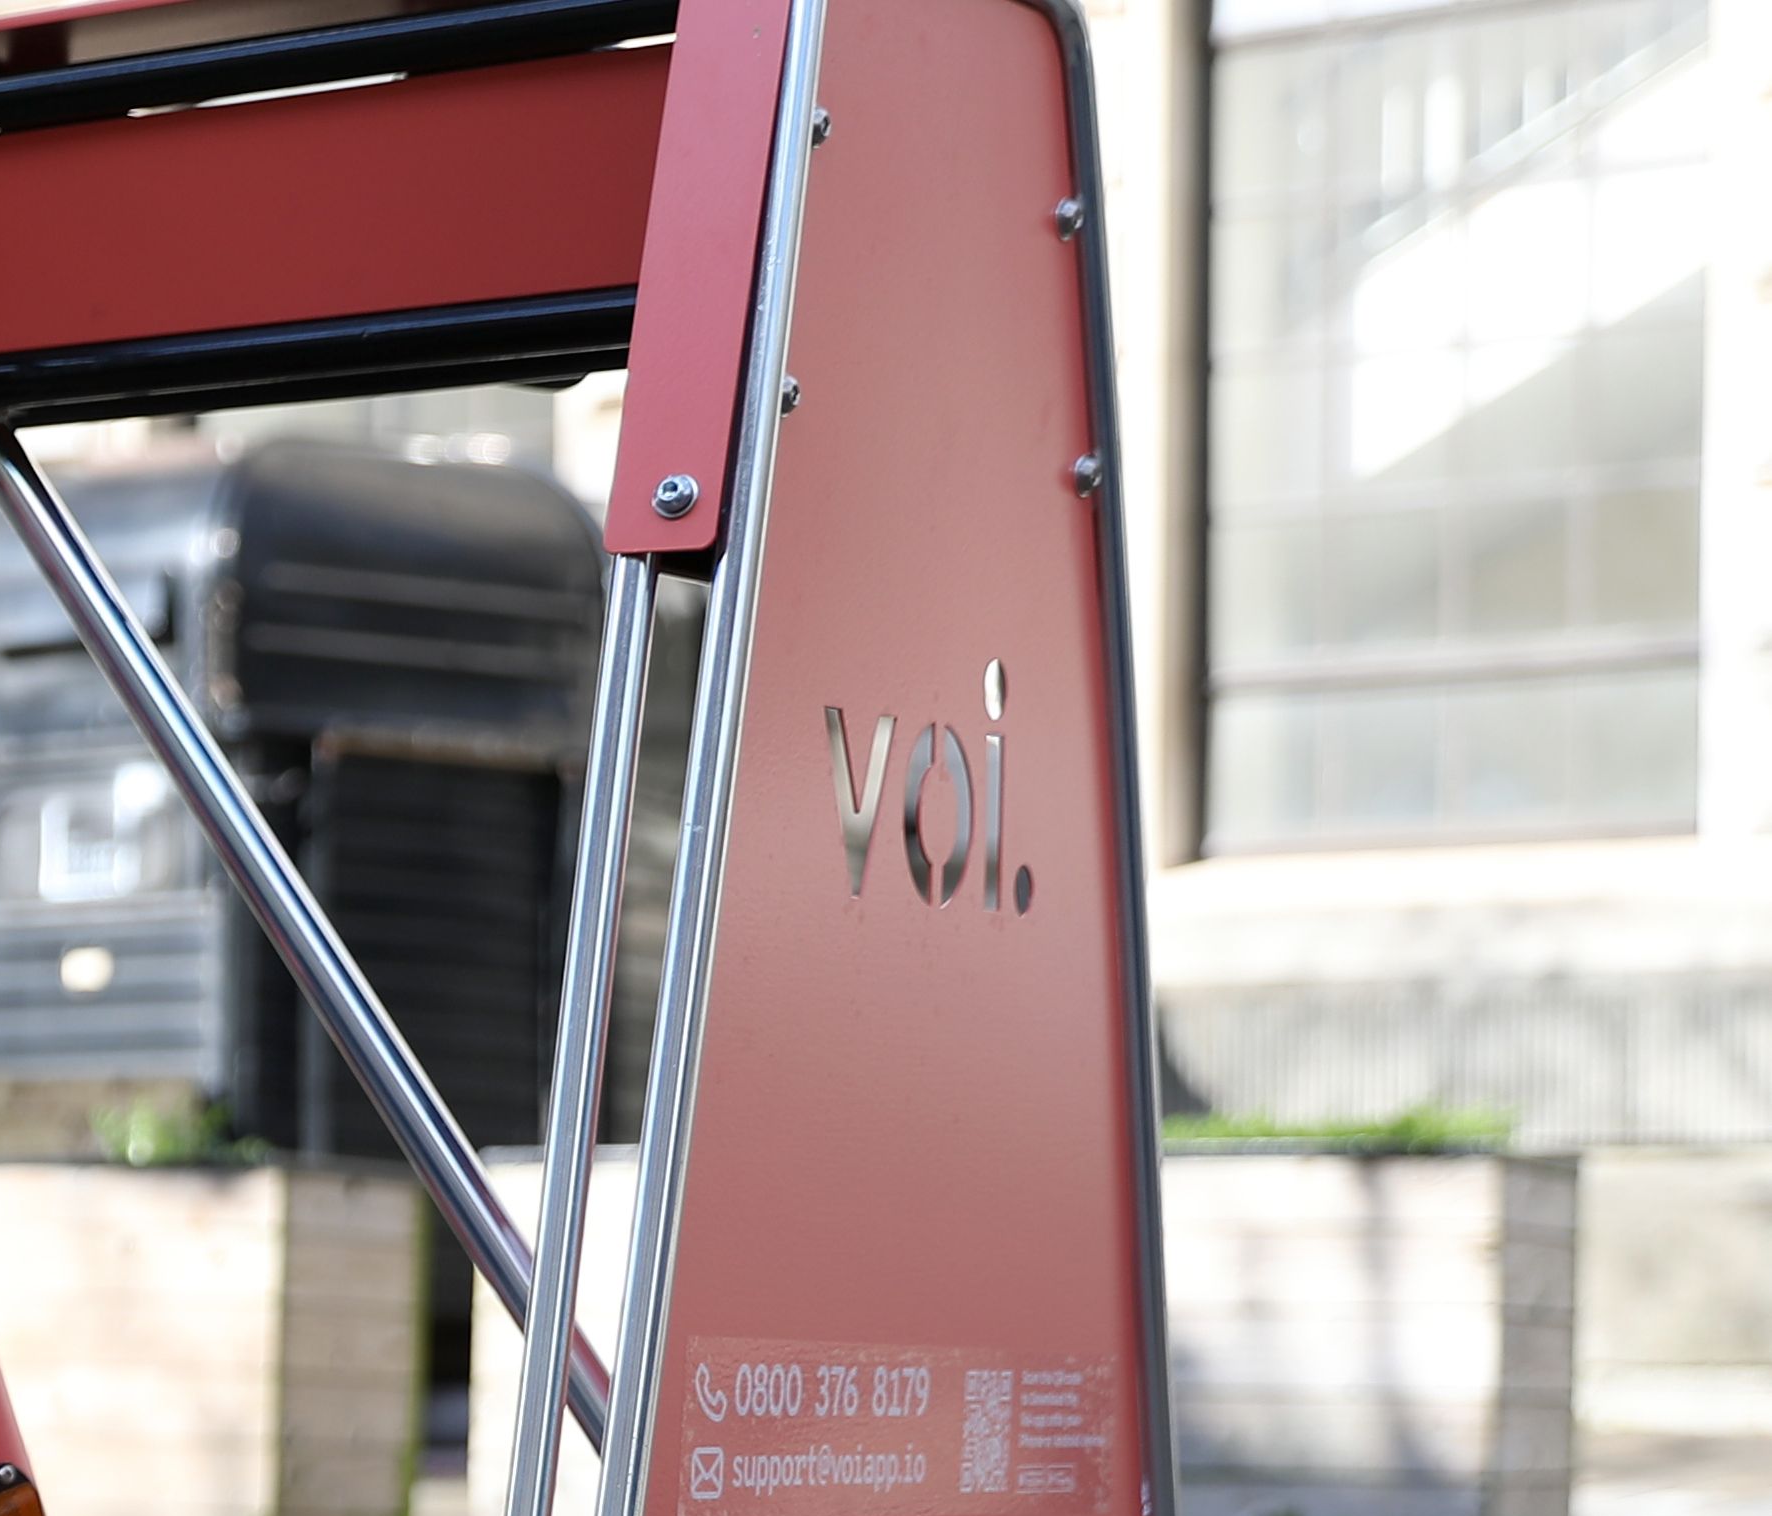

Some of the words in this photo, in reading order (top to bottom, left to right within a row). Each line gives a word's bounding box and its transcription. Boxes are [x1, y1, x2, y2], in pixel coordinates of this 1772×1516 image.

[823, 657, 1033, 917] voi.
[734, 1363, 802, 1417] 0800
[815, 1365, 858, 1417] 376
[872, 1365, 930, 1417] 8179
[732, 1445, 926, 1496] support@voiapp.io
